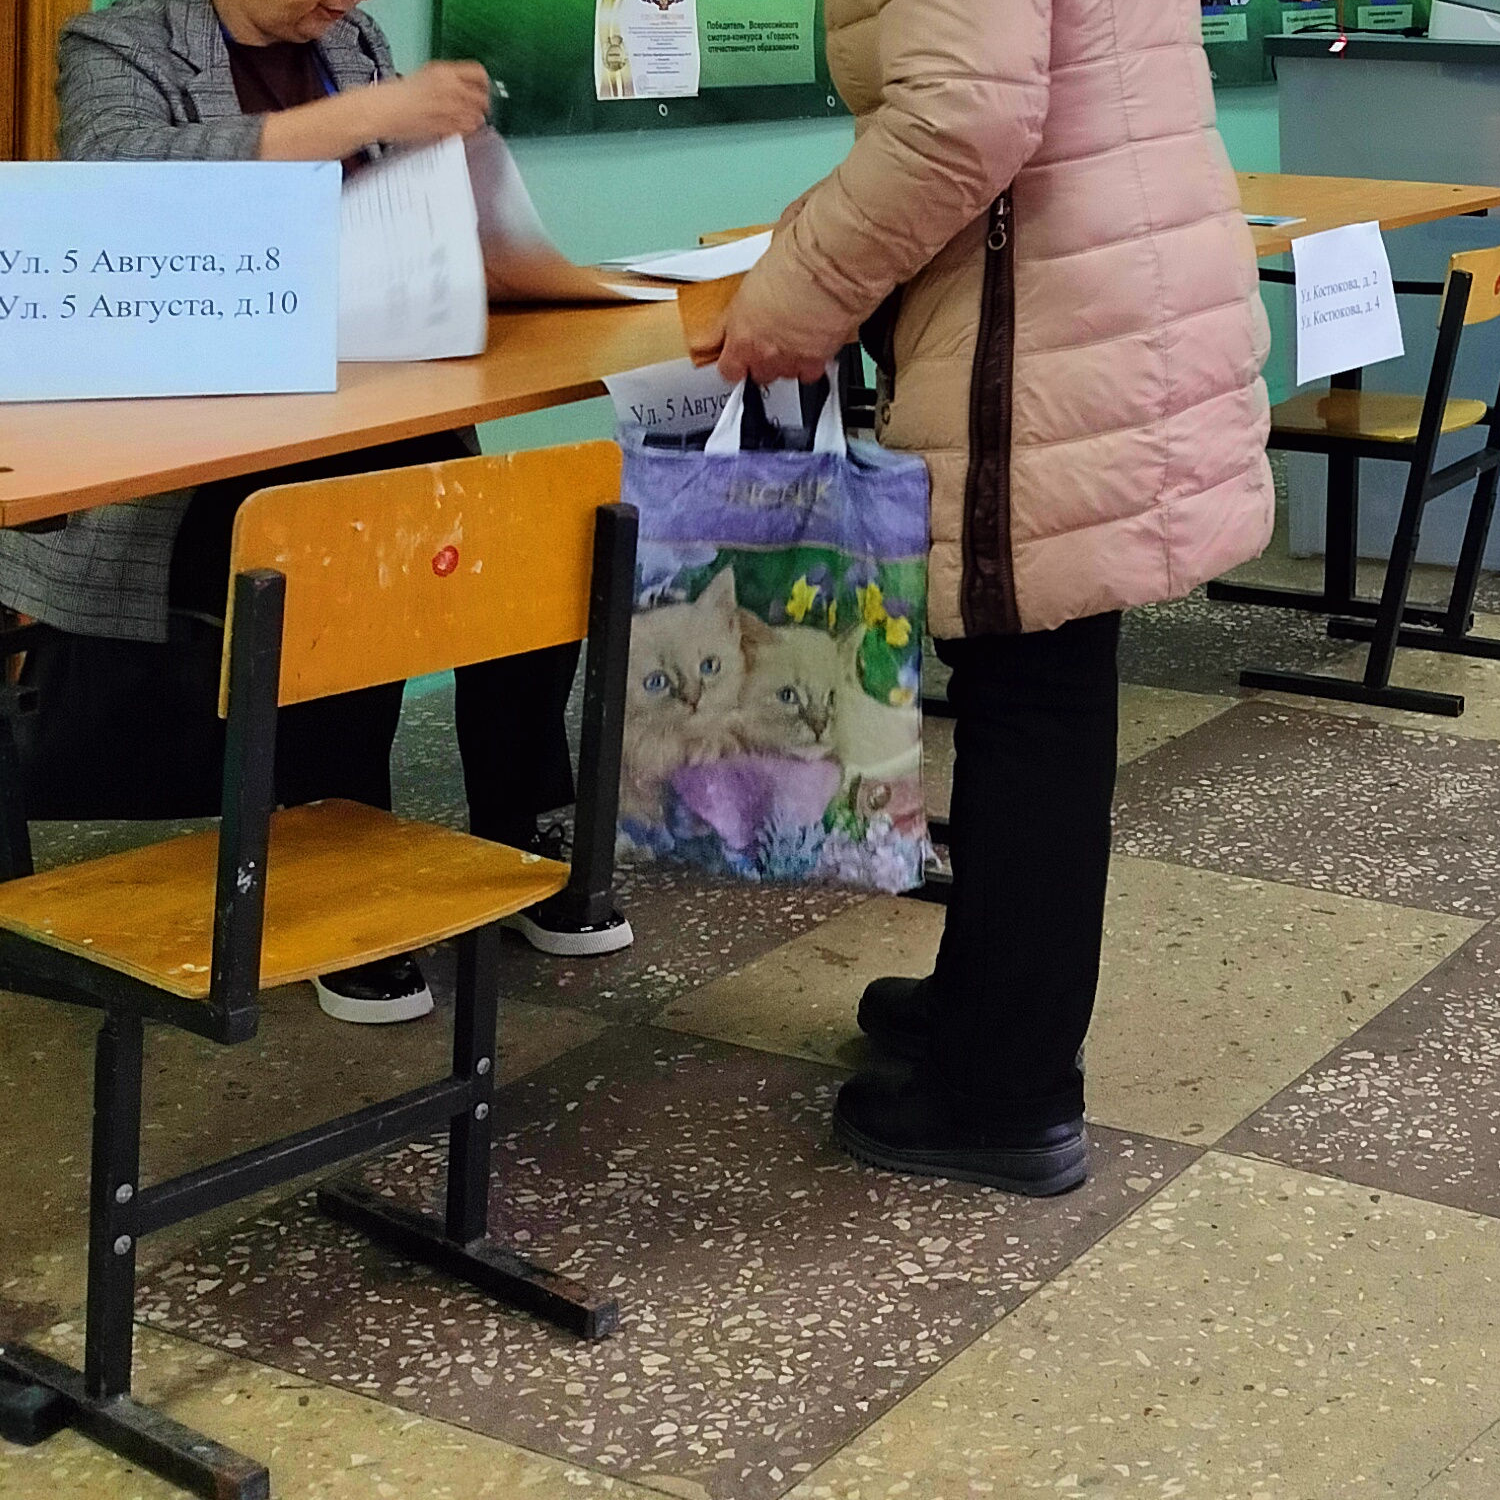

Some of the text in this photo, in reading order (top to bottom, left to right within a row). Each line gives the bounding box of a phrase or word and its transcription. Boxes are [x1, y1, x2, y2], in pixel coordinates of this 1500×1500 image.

[0, 246, 281, 279] Ул. 5 Августа, д.8
[1313, 279, 1361, 300] Костюкова,
[1372, 270, 1378, 285] 2
[0, 290, 298, 324] Ул. 5 Августа, д.10
[1313, 304, 1364, 326] Костюкова,
[1374, 295, 1380, 309] 4
[630, 393, 733, 426] Ул. 5 Авгус
